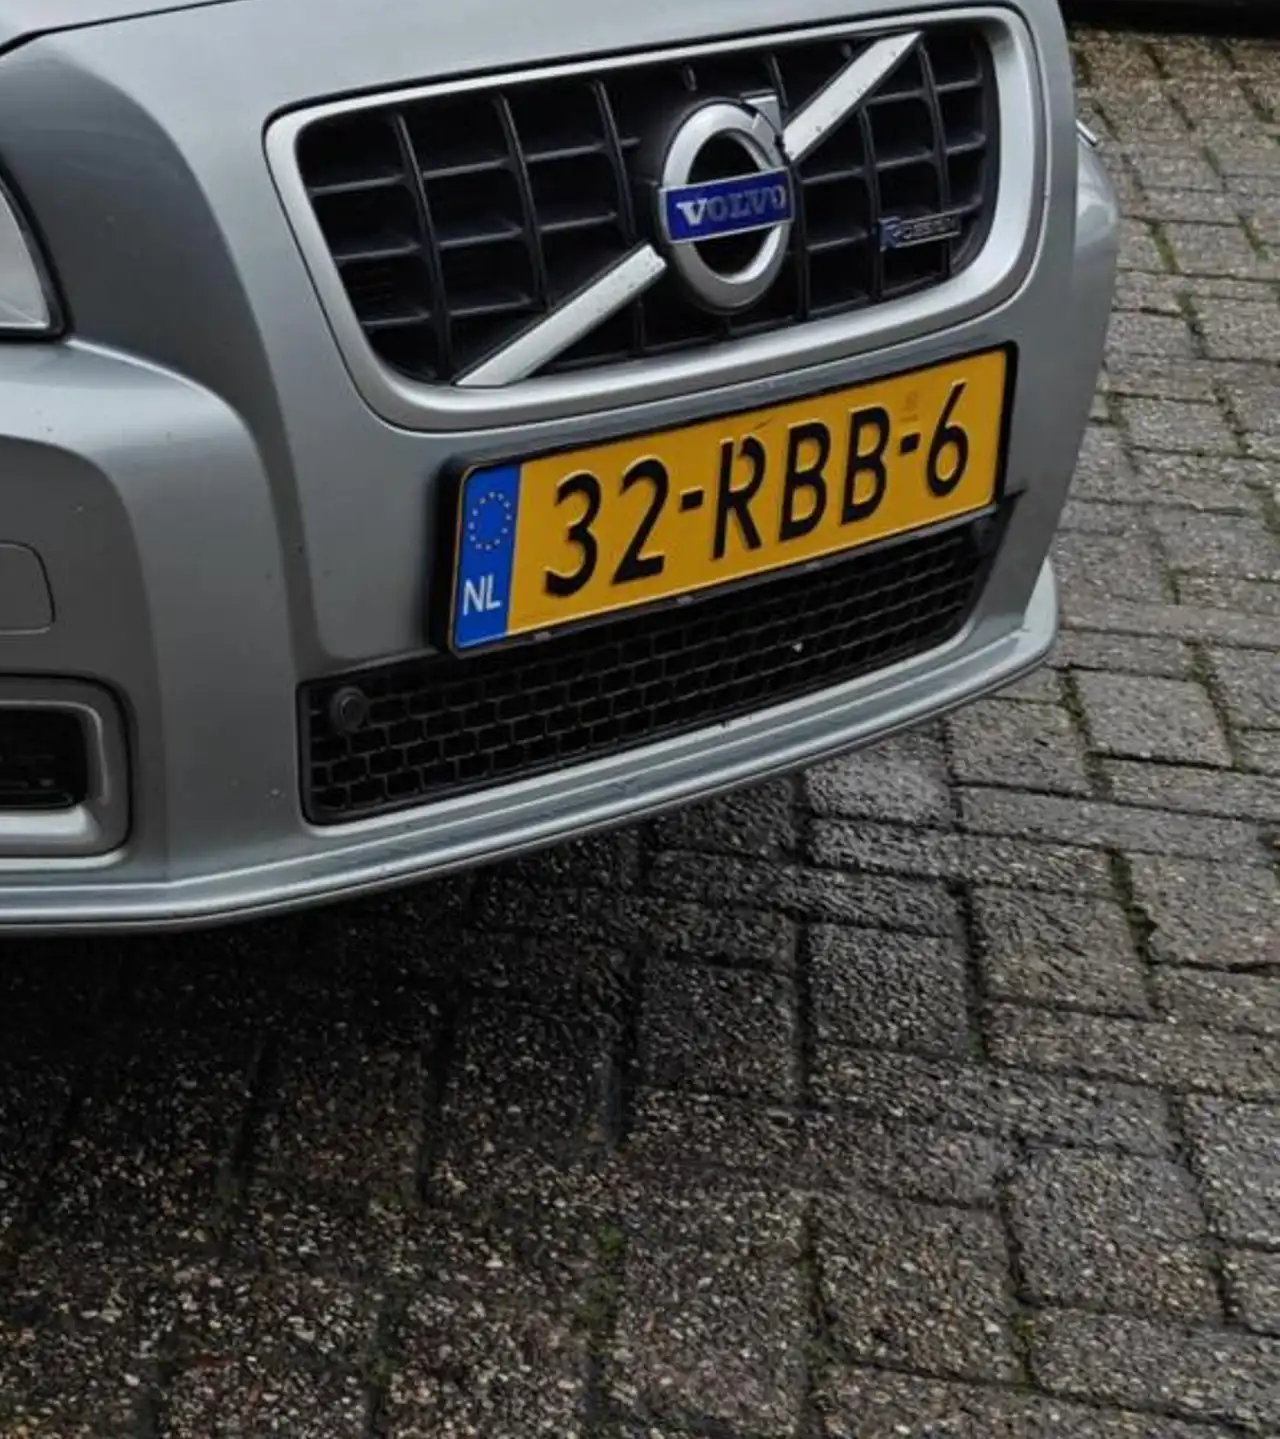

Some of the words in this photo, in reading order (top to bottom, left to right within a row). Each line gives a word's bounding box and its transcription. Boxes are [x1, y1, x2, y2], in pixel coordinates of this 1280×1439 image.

[675, 184, 787, 227] VOLVO
[543, 379, 970, 598] 32-RBB-6
[462, 573, 502, 617] NL
